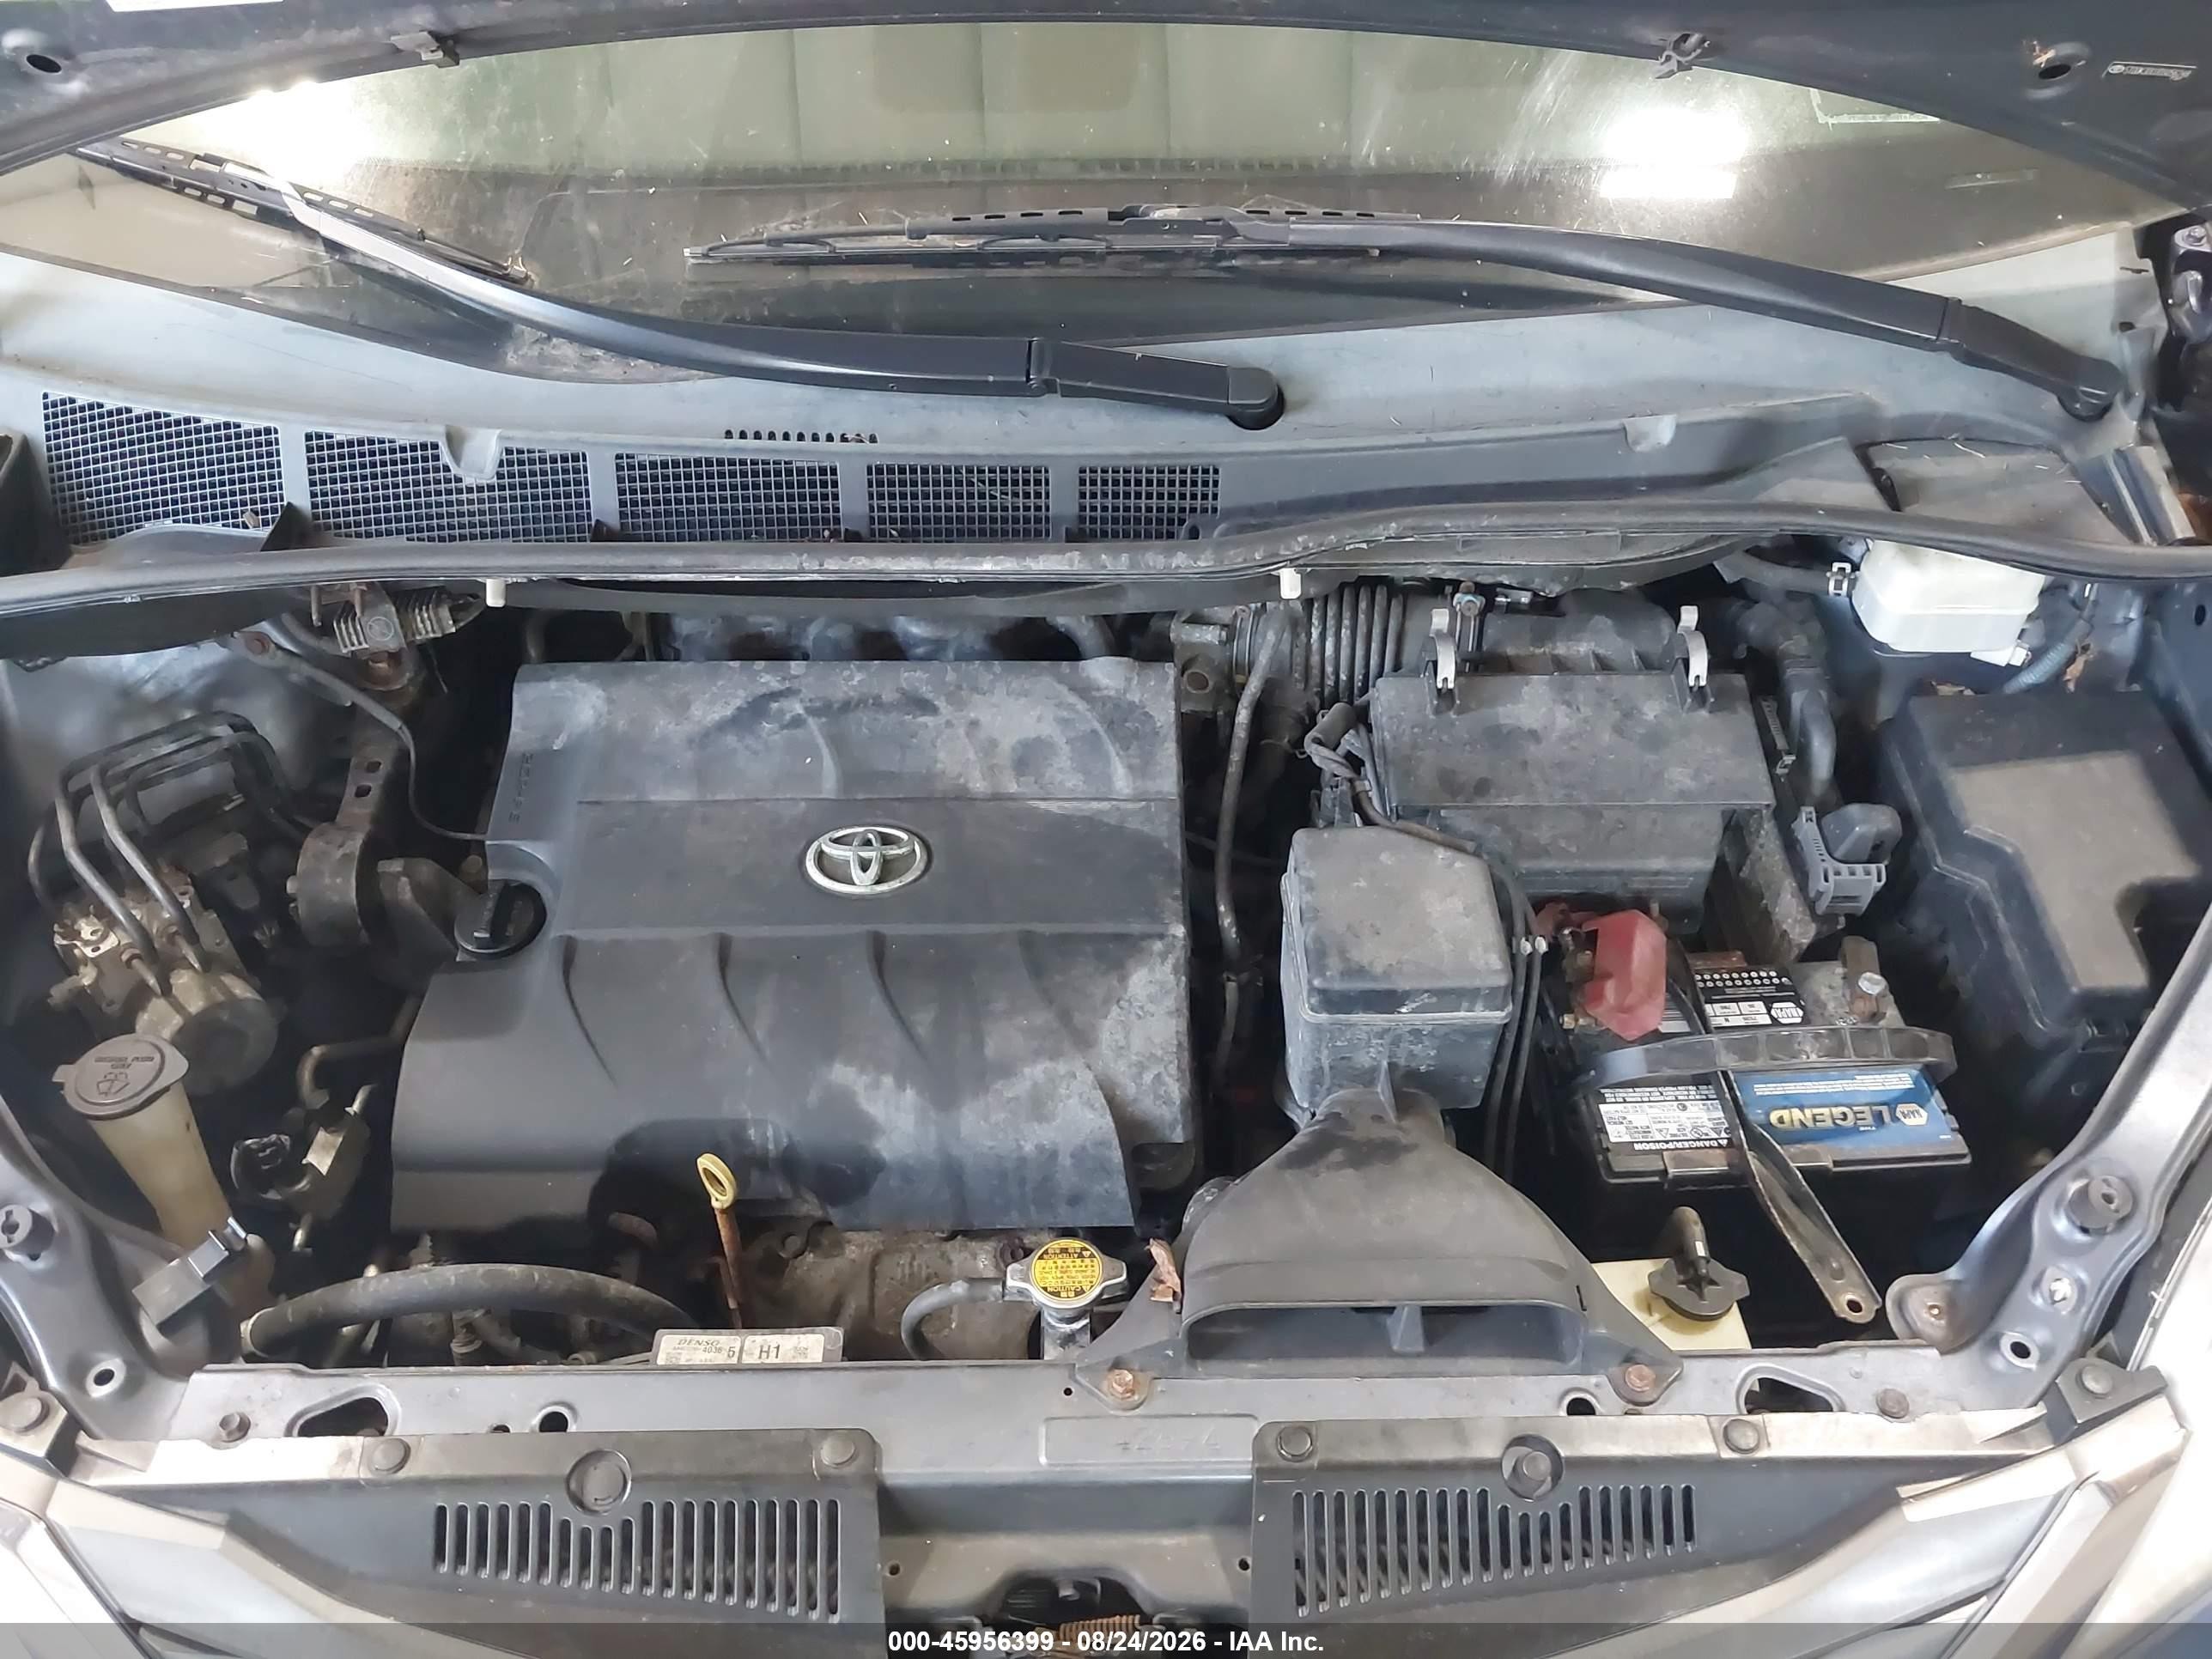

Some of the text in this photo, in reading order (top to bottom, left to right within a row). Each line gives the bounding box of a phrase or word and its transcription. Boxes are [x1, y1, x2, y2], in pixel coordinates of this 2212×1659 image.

[1777, 1008, 1797, 1018] NAPA
[1769, 1105, 1892, 1128] LEGEND
[1899, 1109, 1923, 1119] NAPA
[1634, 1139, 1717, 1150] DANGER/POISON
[727, 1346, 735, 1358] 5
[757, 1345, 781, 1359] H1
